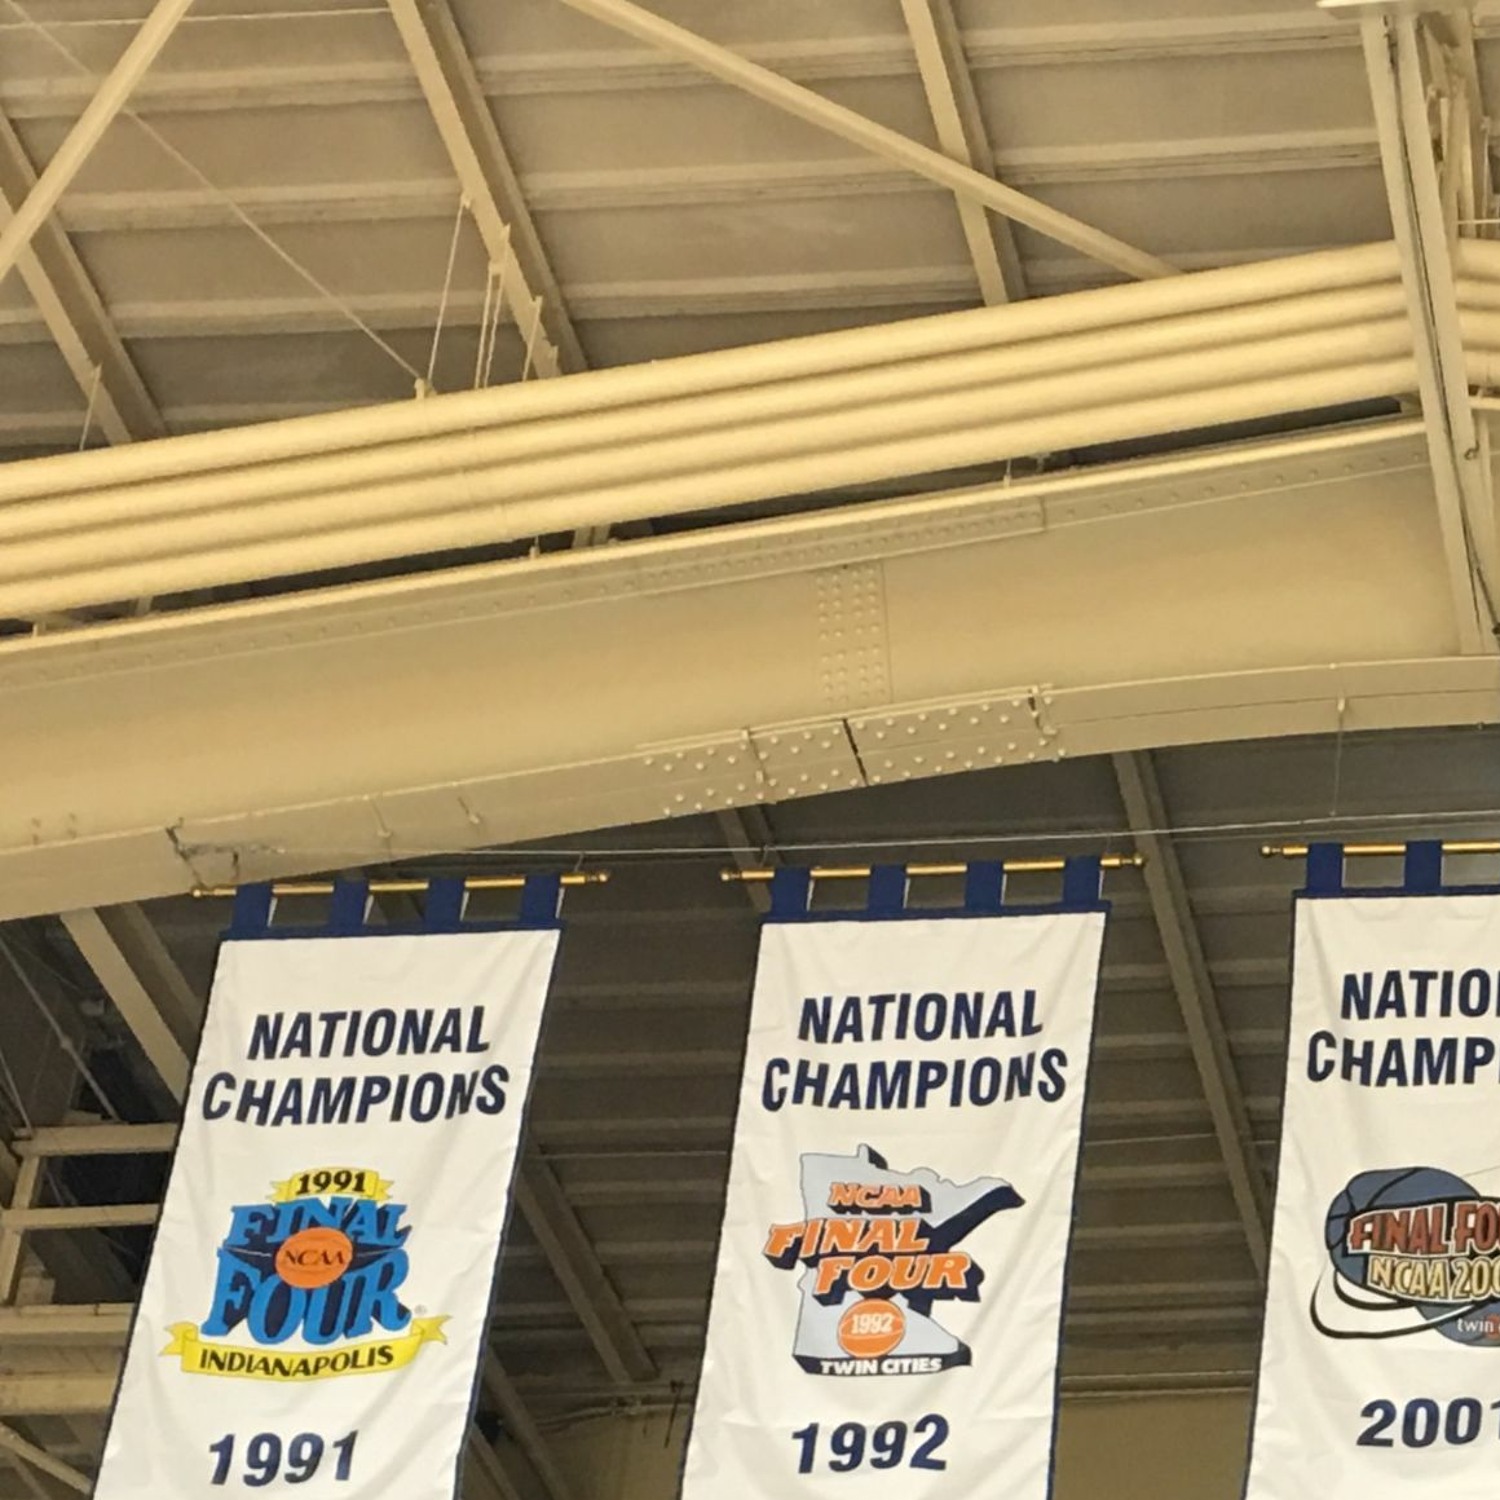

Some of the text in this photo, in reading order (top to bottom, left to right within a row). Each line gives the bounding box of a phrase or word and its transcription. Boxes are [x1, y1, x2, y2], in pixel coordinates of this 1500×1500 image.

[248, 1006, 489, 1059] NATIONAL
[799, 991, 1042, 1043] NATIONAL
[203, 1065, 509, 1126] CHAMPIONS
[763, 1049, 1067, 1111] CHAMPIONS
[297, 1170, 367, 1195] 1991
[828, 1183, 922, 1208] NCAA
[223, 1196, 412, 1249] FINAL
[763, 1218, 930, 1258] FINAL
[1348, 1203, 1450, 1256] FINAL
[284, 1250, 346, 1266] NCAA
[814, 1252, 972, 1294] FOUR
[1368, 1255, 1449, 1299] NCAA
[200, 1247, 412, 1345] FOUR
[851, 1312, 895, 1335] 1992
[1457, 1318, 1494, 1333] twin
[199, 1345, 394, 1377] INDIANAPOLIS
[820, 1357, 942, 1375] TWIN CITIES
[211, 1432, 357, 1486] 1991
[793, 1415, 948, 1473] 1992
